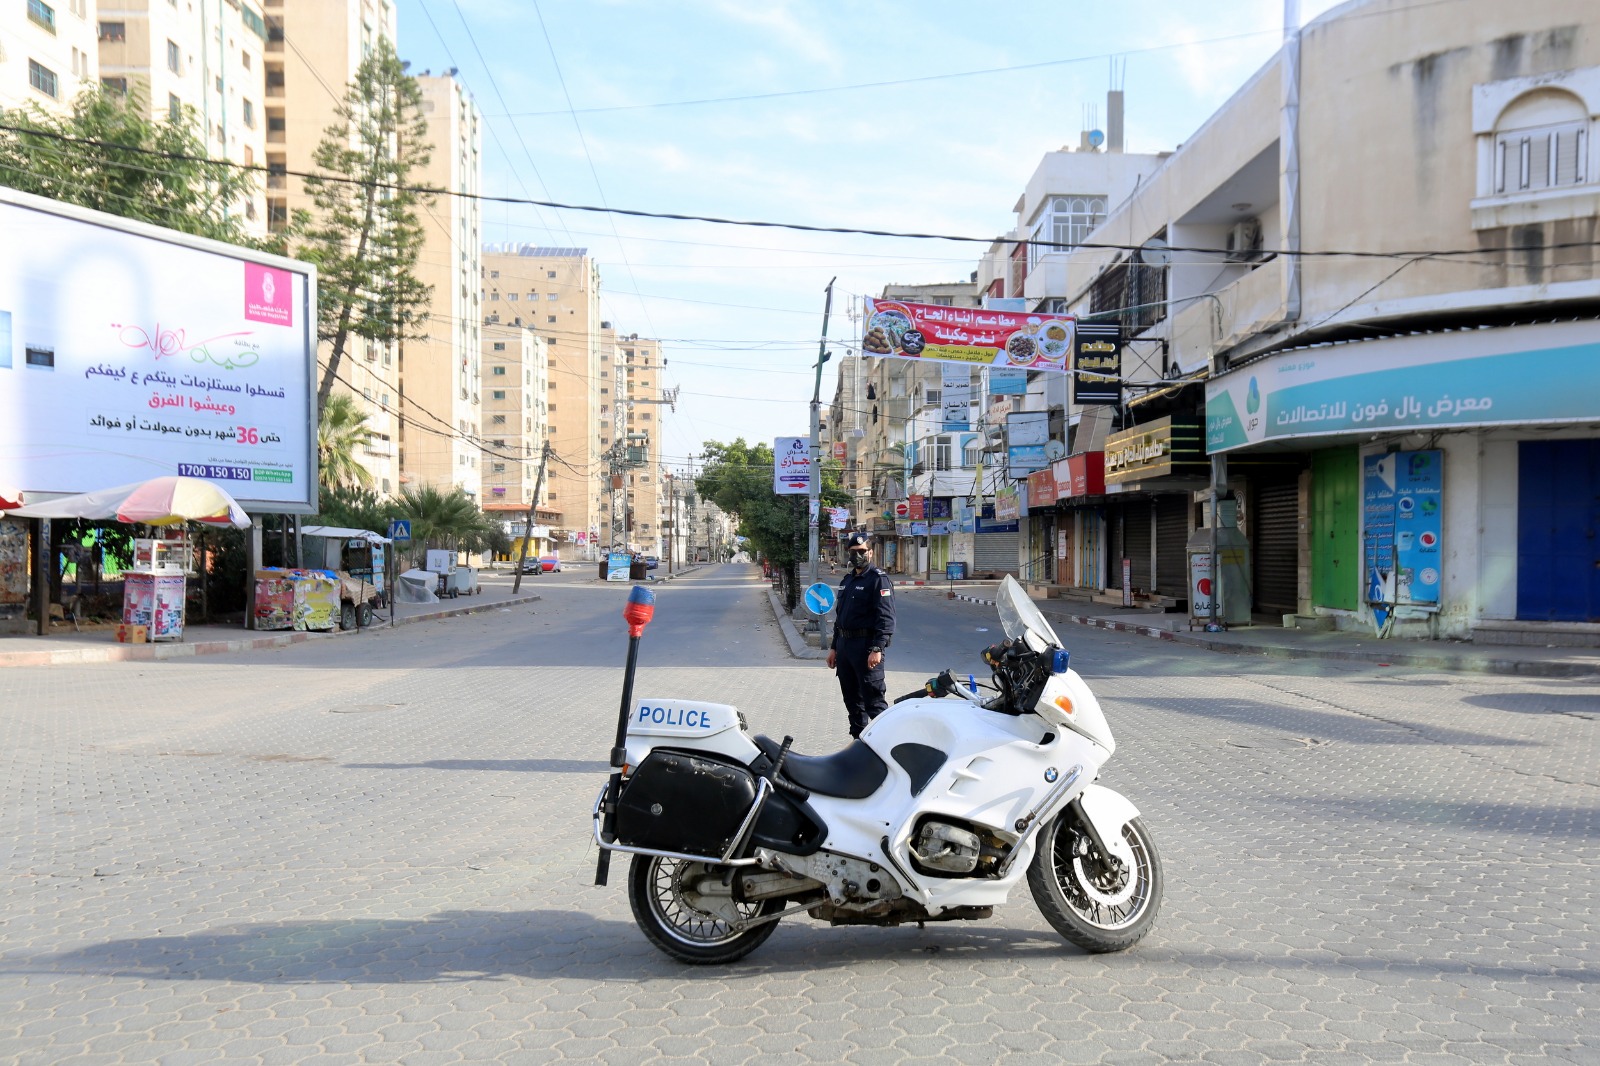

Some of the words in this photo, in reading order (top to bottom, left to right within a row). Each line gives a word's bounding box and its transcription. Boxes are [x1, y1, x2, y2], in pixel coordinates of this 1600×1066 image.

[915, 308, 947, 322] الحاج
[948, 310, 974, 326] أبناء
[976, 314, 1016, 327] مطاعم
[935, 326, 968, 344] عكيلة
[969, 330, 995, 344] نمر
[85, 363, 126, 382] كيفكم
[1278, 364, 1297, 374] معتمد
[1298, 360, 1316, 372] موزع
[131, 371, 140, 385] ع
[143, 369, 176, 388] بيتكم
[180, 374, 242, 393] مستلزمات
[245, 383, 286, 399] قسطوا
[148, 391, 185, 409] الفرق
[189, 395, 236, 416] وعيشوا
[1395, 396, 1422, 418] بال
[1428, 396, 1493, 418] معرض
[1276, 401, 1347, 426] للاتصالات
[1352, 398, 1389, 422] فون
[89, 414, 122, 430] فوائد
[125, 414, 136, 431] أو
[140, 419, 182, 434] عمولات
[185, 425, 212, 440] بدون
[214, 426, 236, 440] شهر
[236, 426, 259, 444] 36
[260, 431, 282, 444] حتى
[180, 464, 206, 477] 1700
[210, 466, 228, 478] 150
[232, 468, 250, 480] 150
[638, 706, 710, 728] POLICE
